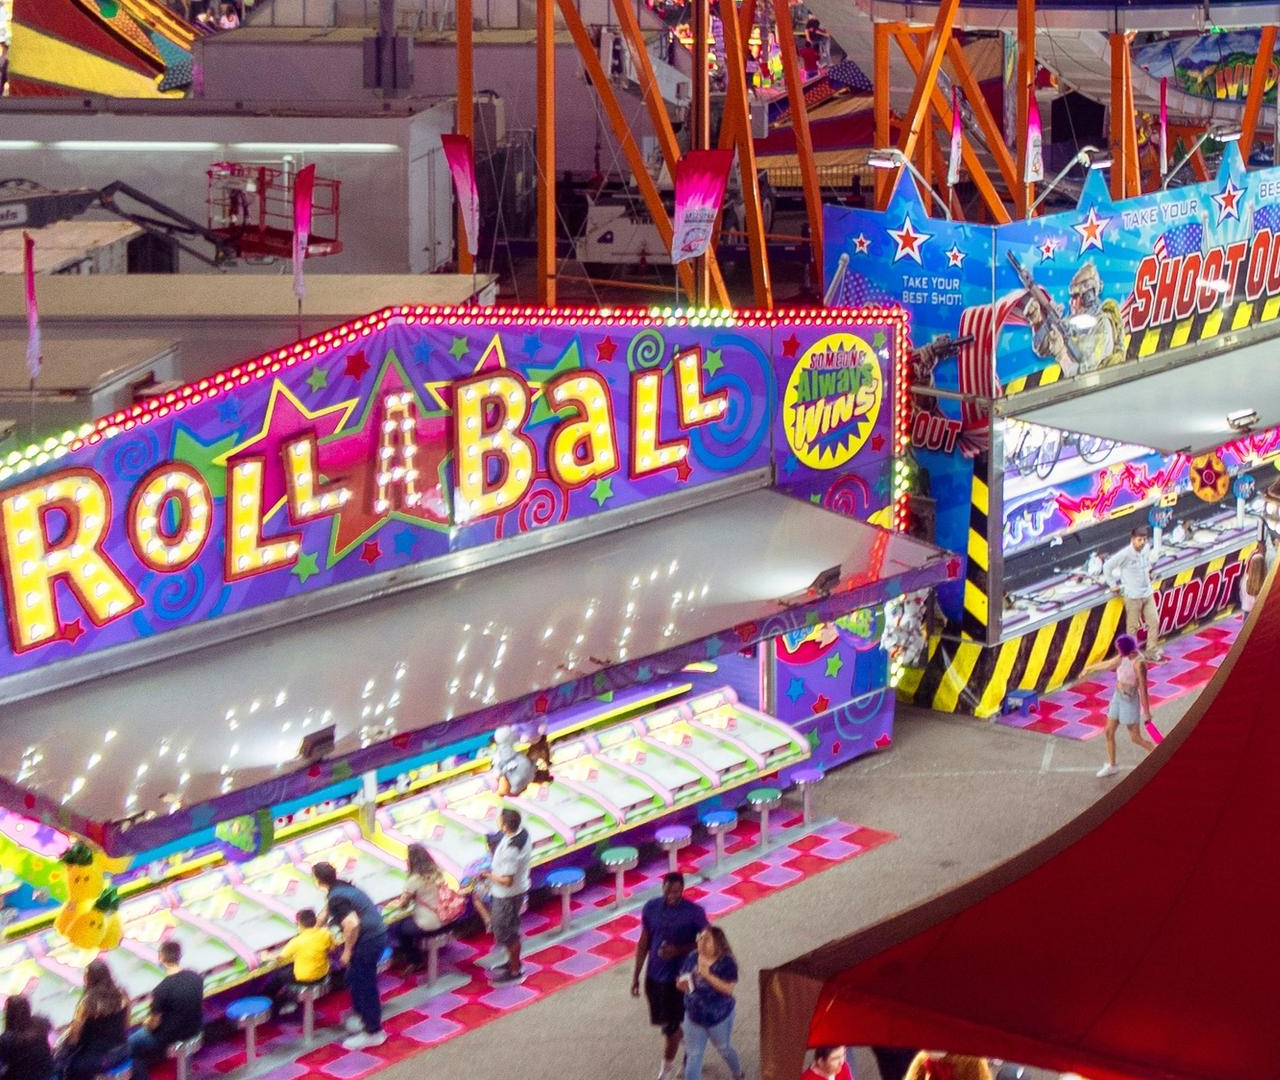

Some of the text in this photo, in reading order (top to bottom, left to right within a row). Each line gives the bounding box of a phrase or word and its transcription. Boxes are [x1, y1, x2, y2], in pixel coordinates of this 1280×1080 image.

[1216, 58, 1278, 100] WID
[1122, 208, 1158, 230] TAKE
[1162, 199, 1199, 219] YOUR
[903, 275, 960, 290] TAKE YOUR
[903, 291, 962, 306] BEST SHOT!
[1129, 242, 1248, 331] SHOOT
[912, 411, 962, 454] OUT
[0, 428, 354, 655] ROLL
[372, 385, 421, 516] A
[1153, 560, 1242, 642] HOOT
